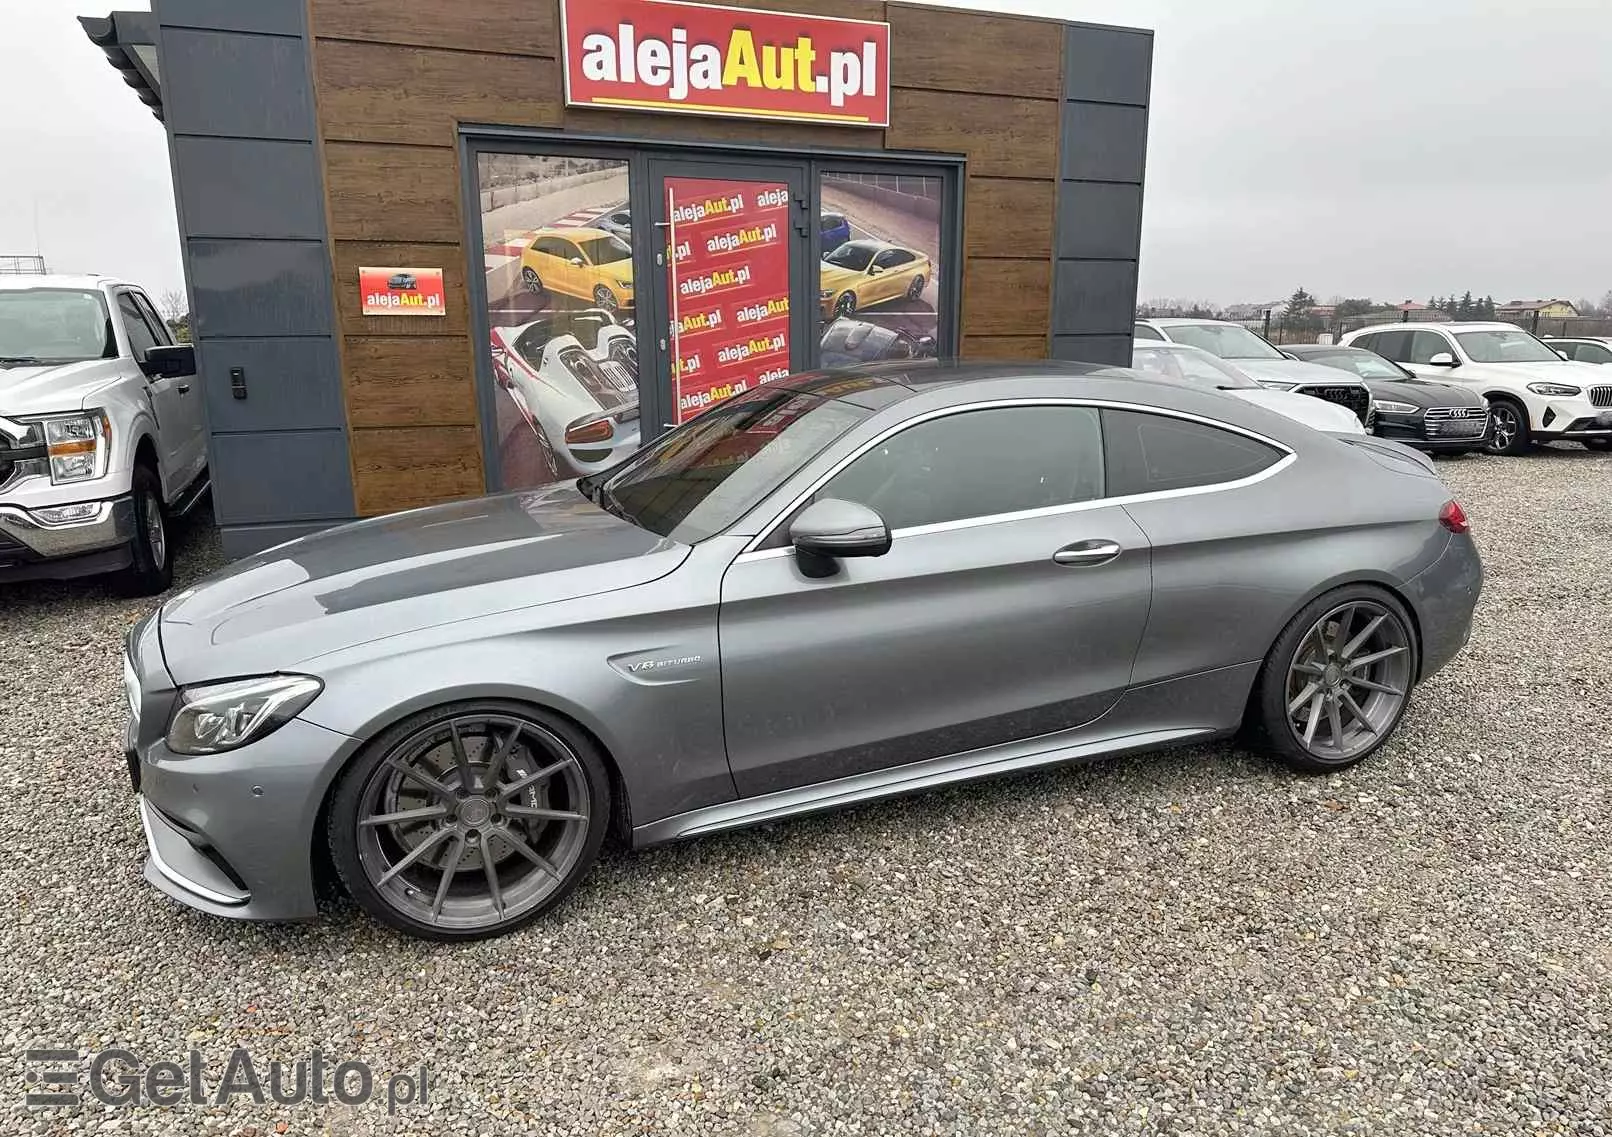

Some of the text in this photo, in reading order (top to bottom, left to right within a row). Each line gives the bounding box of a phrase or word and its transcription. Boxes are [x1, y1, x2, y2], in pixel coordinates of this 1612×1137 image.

[581, 23, 877, 107] alejaAut.pl
[673, 189, 788, 222] alejaAut.pl aleja
[707, 223, 777, 252] alejaAut.pl
[680, 265, 751, 295] alejaAut.pl
[367, 292, 440, 308] alejaAut.pl
[736, 297, 789, 322] alejaAut
[718, 334, 785, 361] alejaAut.pl
[680, 380, 747, 410] alejaAut.pl
